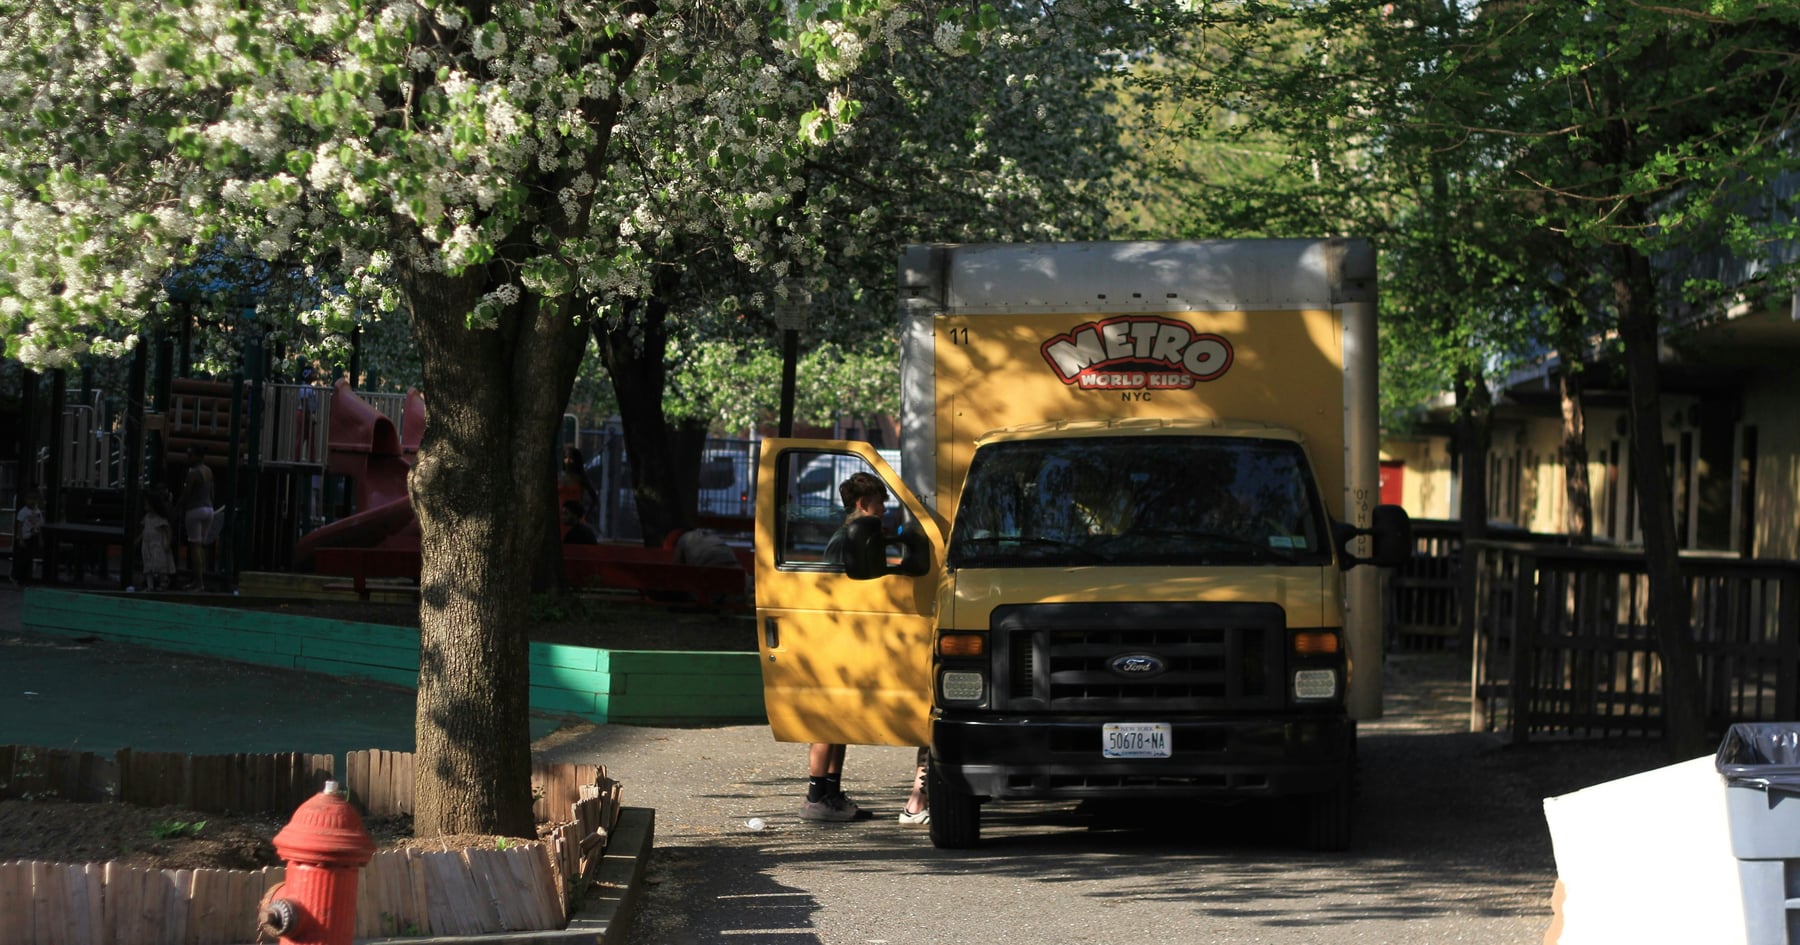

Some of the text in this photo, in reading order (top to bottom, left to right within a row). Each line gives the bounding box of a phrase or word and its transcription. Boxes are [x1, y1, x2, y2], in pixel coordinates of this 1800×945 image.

[949, 327, 970, 346] 11
[1047, 321, 1228, 379] METRO
[1081, 374, 1192, 386] WORLD KIDS
[1121, 391, 1152, 402] NYC
[1124, 658, 1152, 672] Ford
